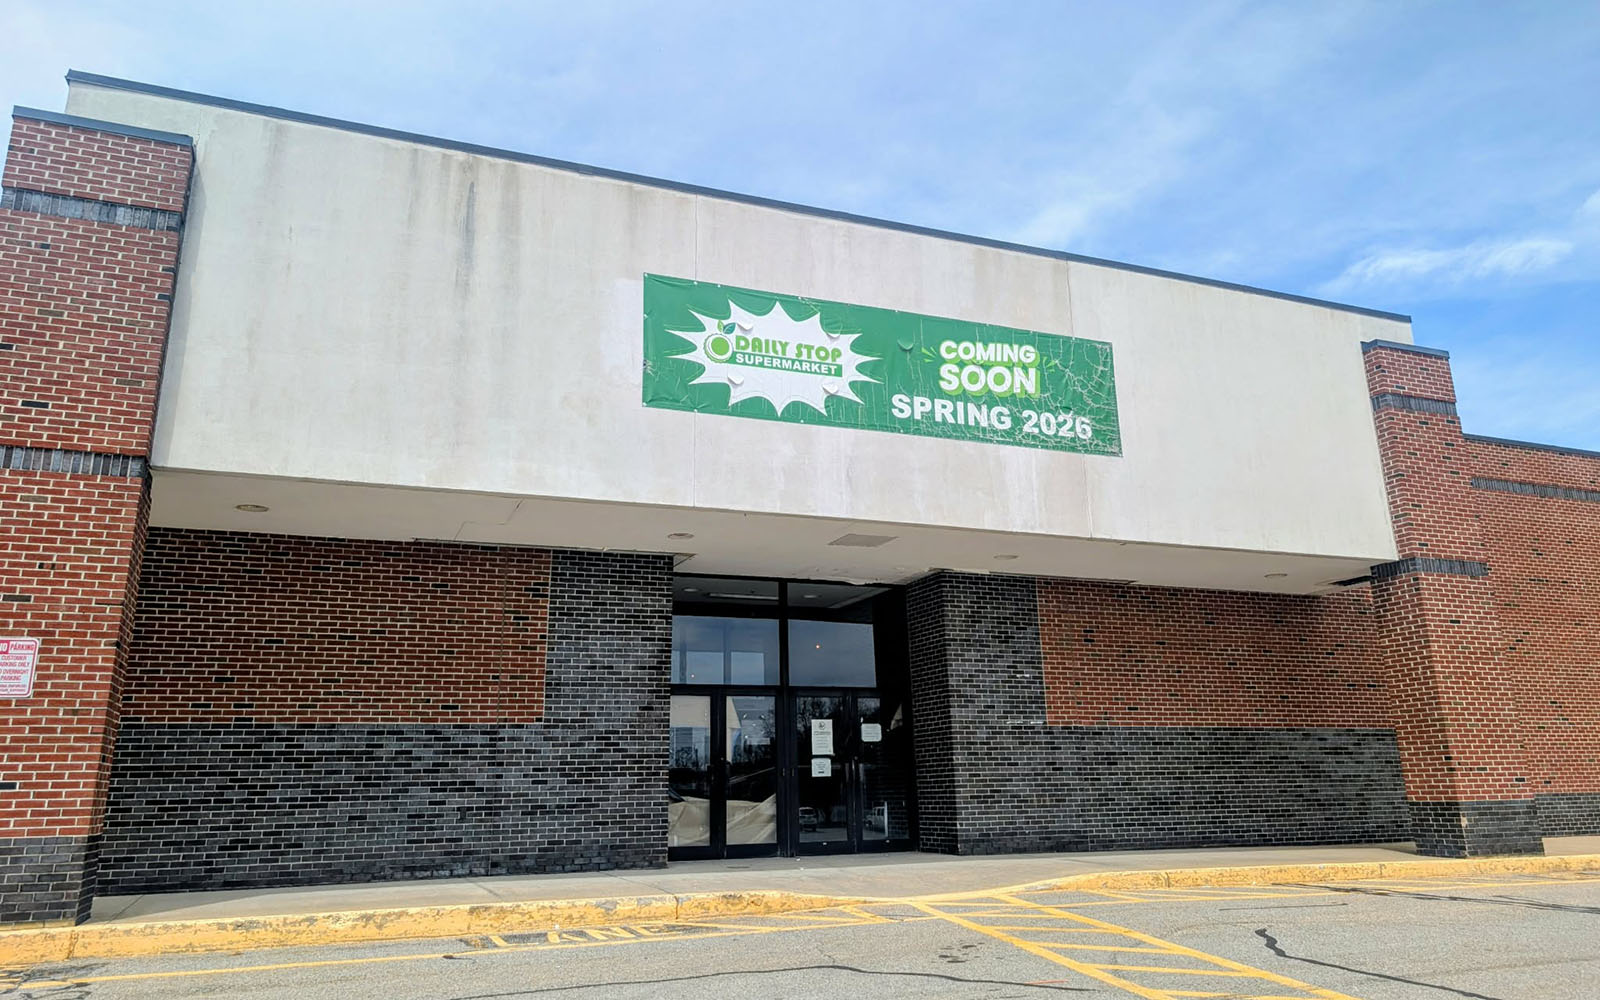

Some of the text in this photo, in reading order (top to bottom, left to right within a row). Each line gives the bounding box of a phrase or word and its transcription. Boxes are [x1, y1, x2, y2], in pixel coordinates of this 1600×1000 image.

[735, 335, 843, 363] DAILY STOP
[939, 341, 1036, 364] COMING
[735, 354, 838, 375] SUPERMARKET
[938, 363, 1037, 394] SOON
[891, 393, 1093, 440] SPRING 2026
